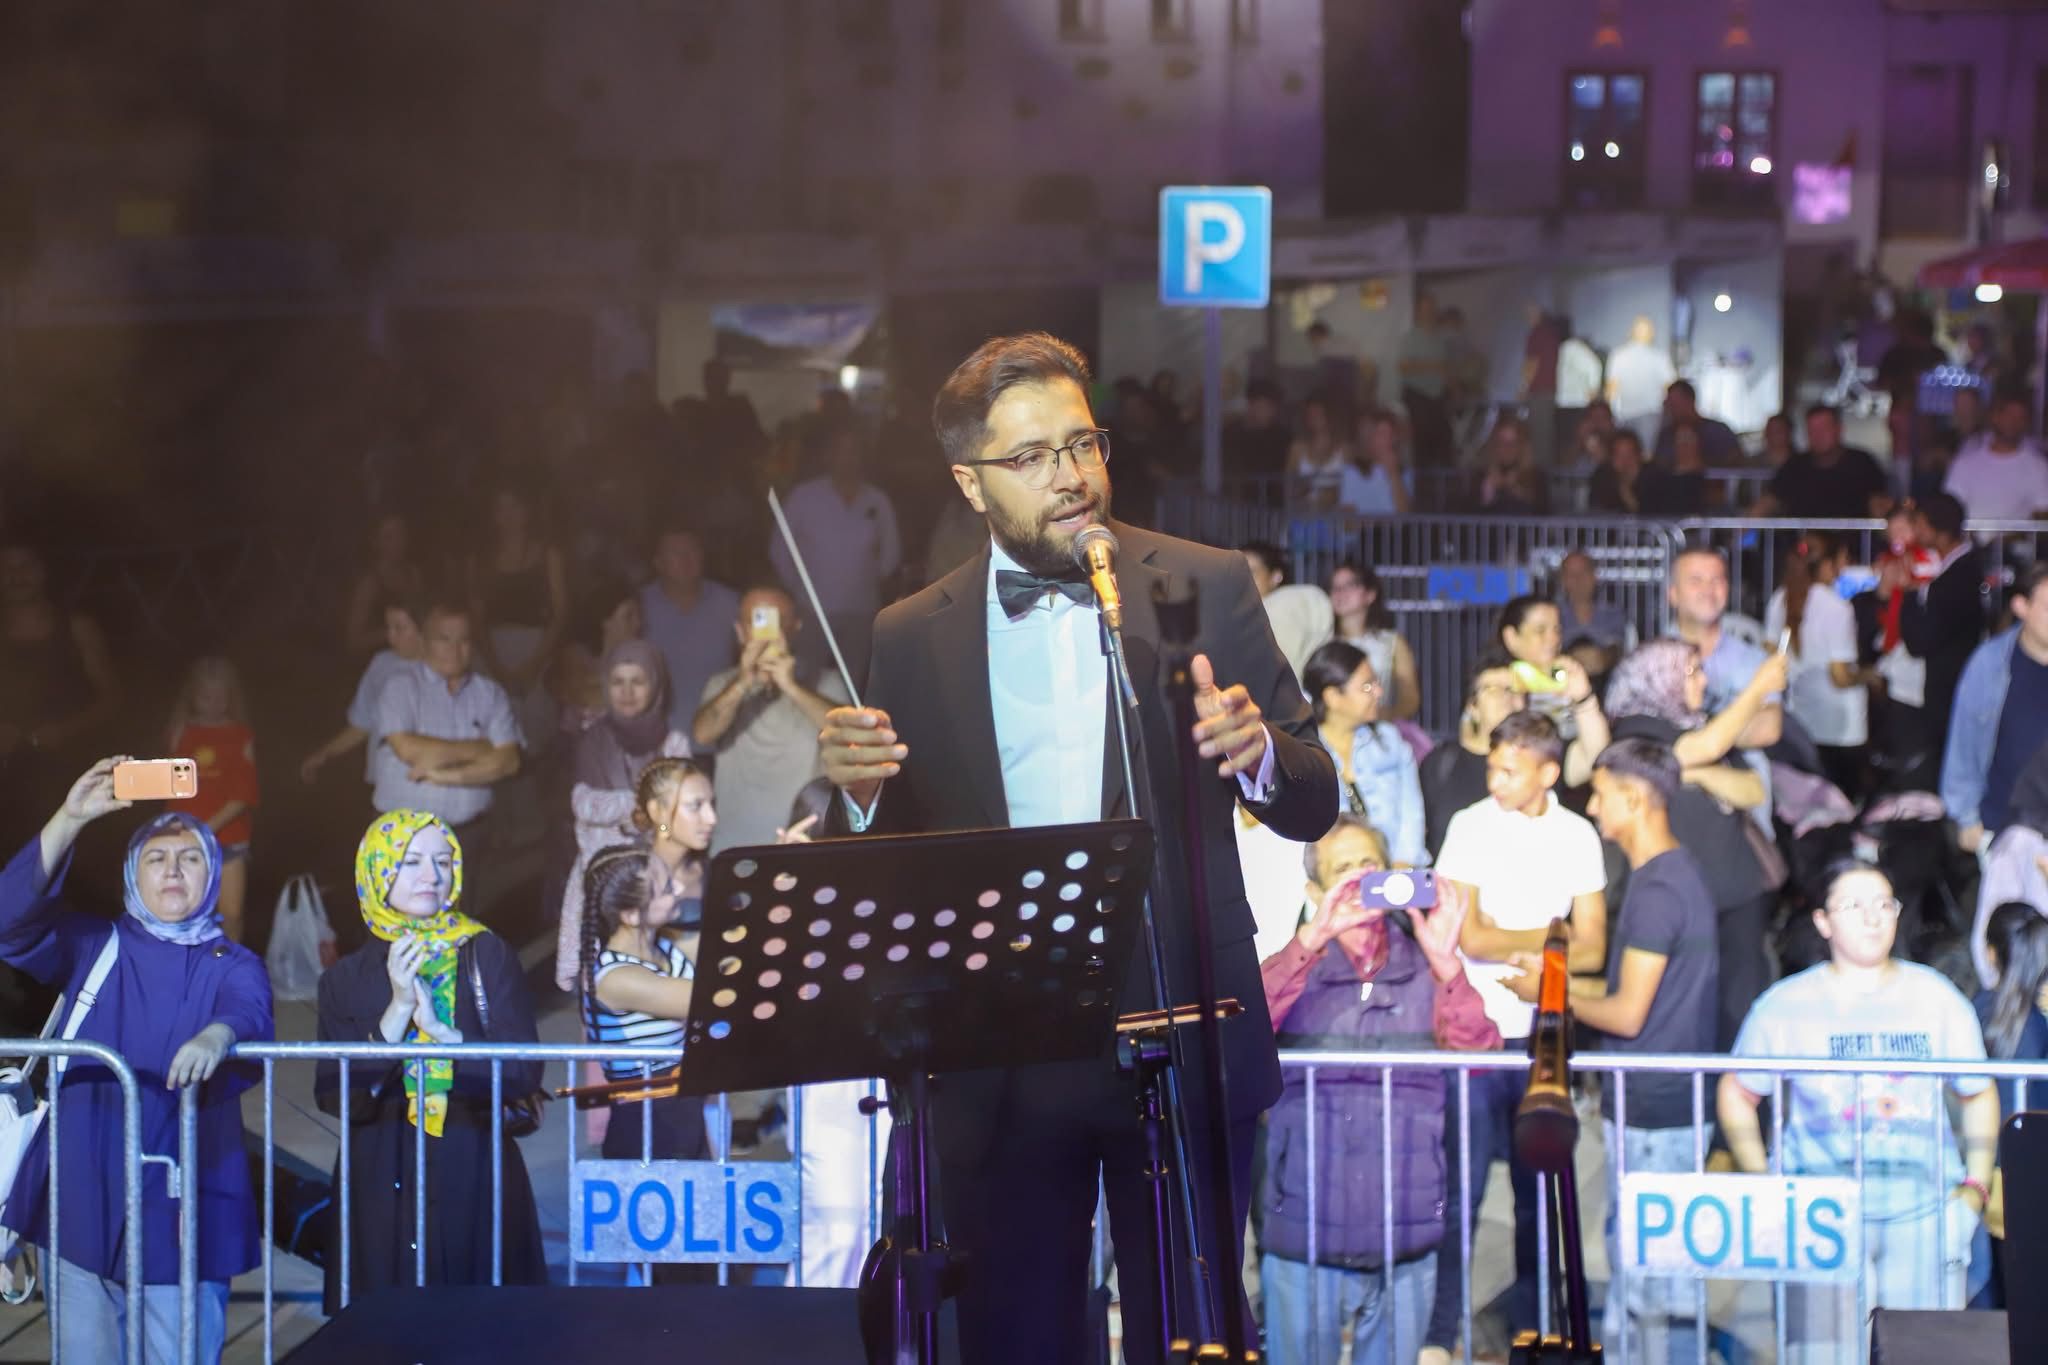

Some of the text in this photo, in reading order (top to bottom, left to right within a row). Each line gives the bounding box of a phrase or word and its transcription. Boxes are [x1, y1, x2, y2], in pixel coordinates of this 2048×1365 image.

[1184, 200, 1246, 293] P
[583, 1167, 784, 1253] POLİS
[1637, 1182, 1845, 1270] POLİS
